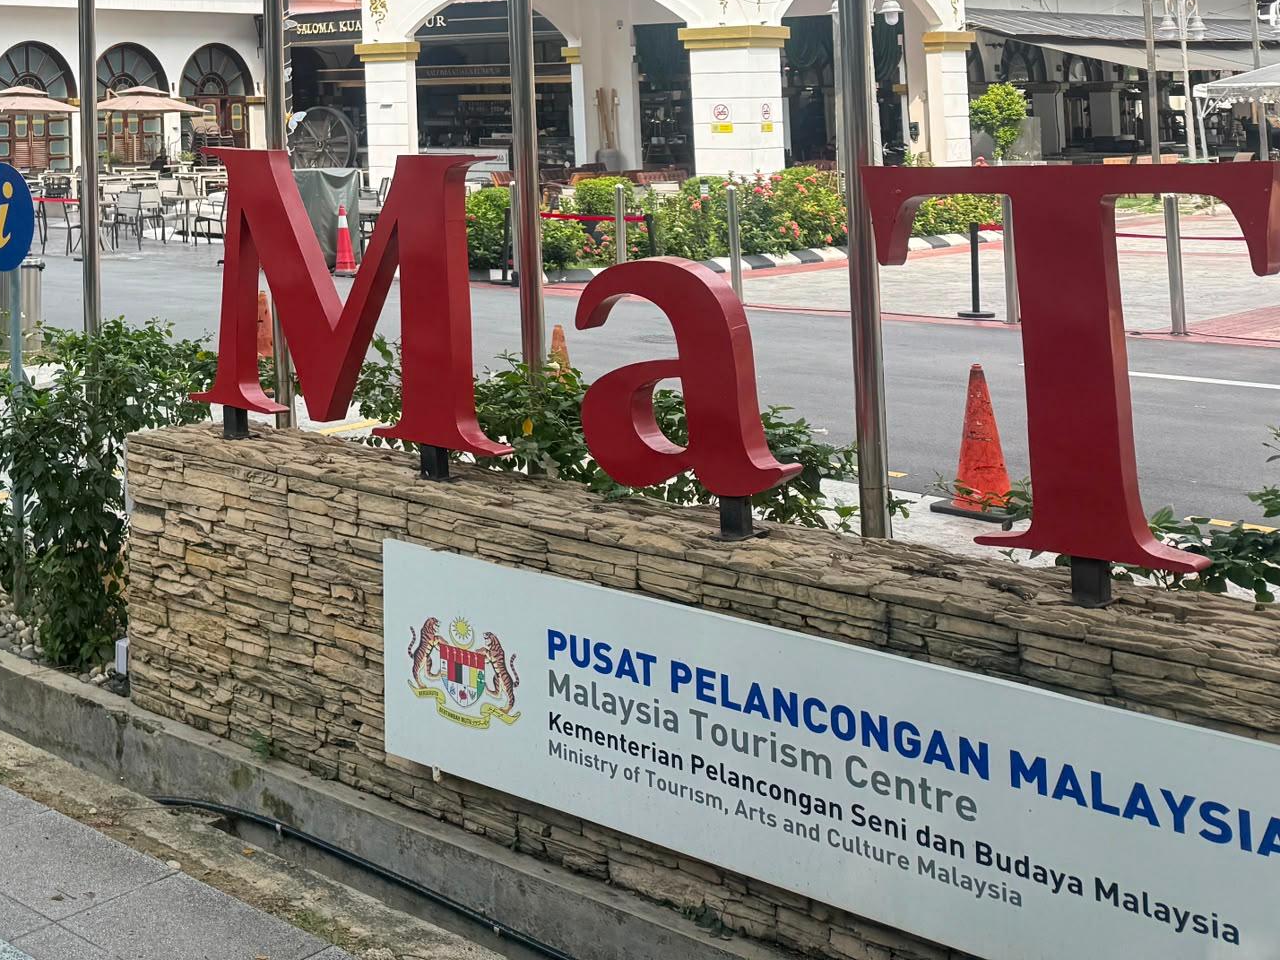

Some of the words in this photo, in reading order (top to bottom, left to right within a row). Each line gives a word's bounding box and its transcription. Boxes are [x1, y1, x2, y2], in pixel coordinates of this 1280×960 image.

[296, 21, 337, 34] SALOMA
[339, 20, 362, 33] KUA
[188, 146, 1280, 573] MaT
[547, 628, 657, 687] PUSAT
[670, 659, 990, 781] PELANCONGAN
[548, 669, 679, 734] Malaysia
[689, 708, 832, 780] Tourism
[845, 755, 978, 822] Centre
[548, 738, 618, 779] Ministry
[623, 765, 641, 783] of
[645, 769, 728, 816] Tourism,
[734, 799, 777, 828] Arts
[783, 818, 820, 843] and
[827, 828, 910, 871] Culture
[918, 855, 1022, 907] Malaysia
[548, 711, 683, 771] Kementerian
[691, 754, 843, 821] Pelancongan
[851, 803, 907, 841] Seni
[916, 825, 965, 859] dan
[975, 840, 1083, 896] Budaya
[1094, 877, 1240, 945] Malaysia
